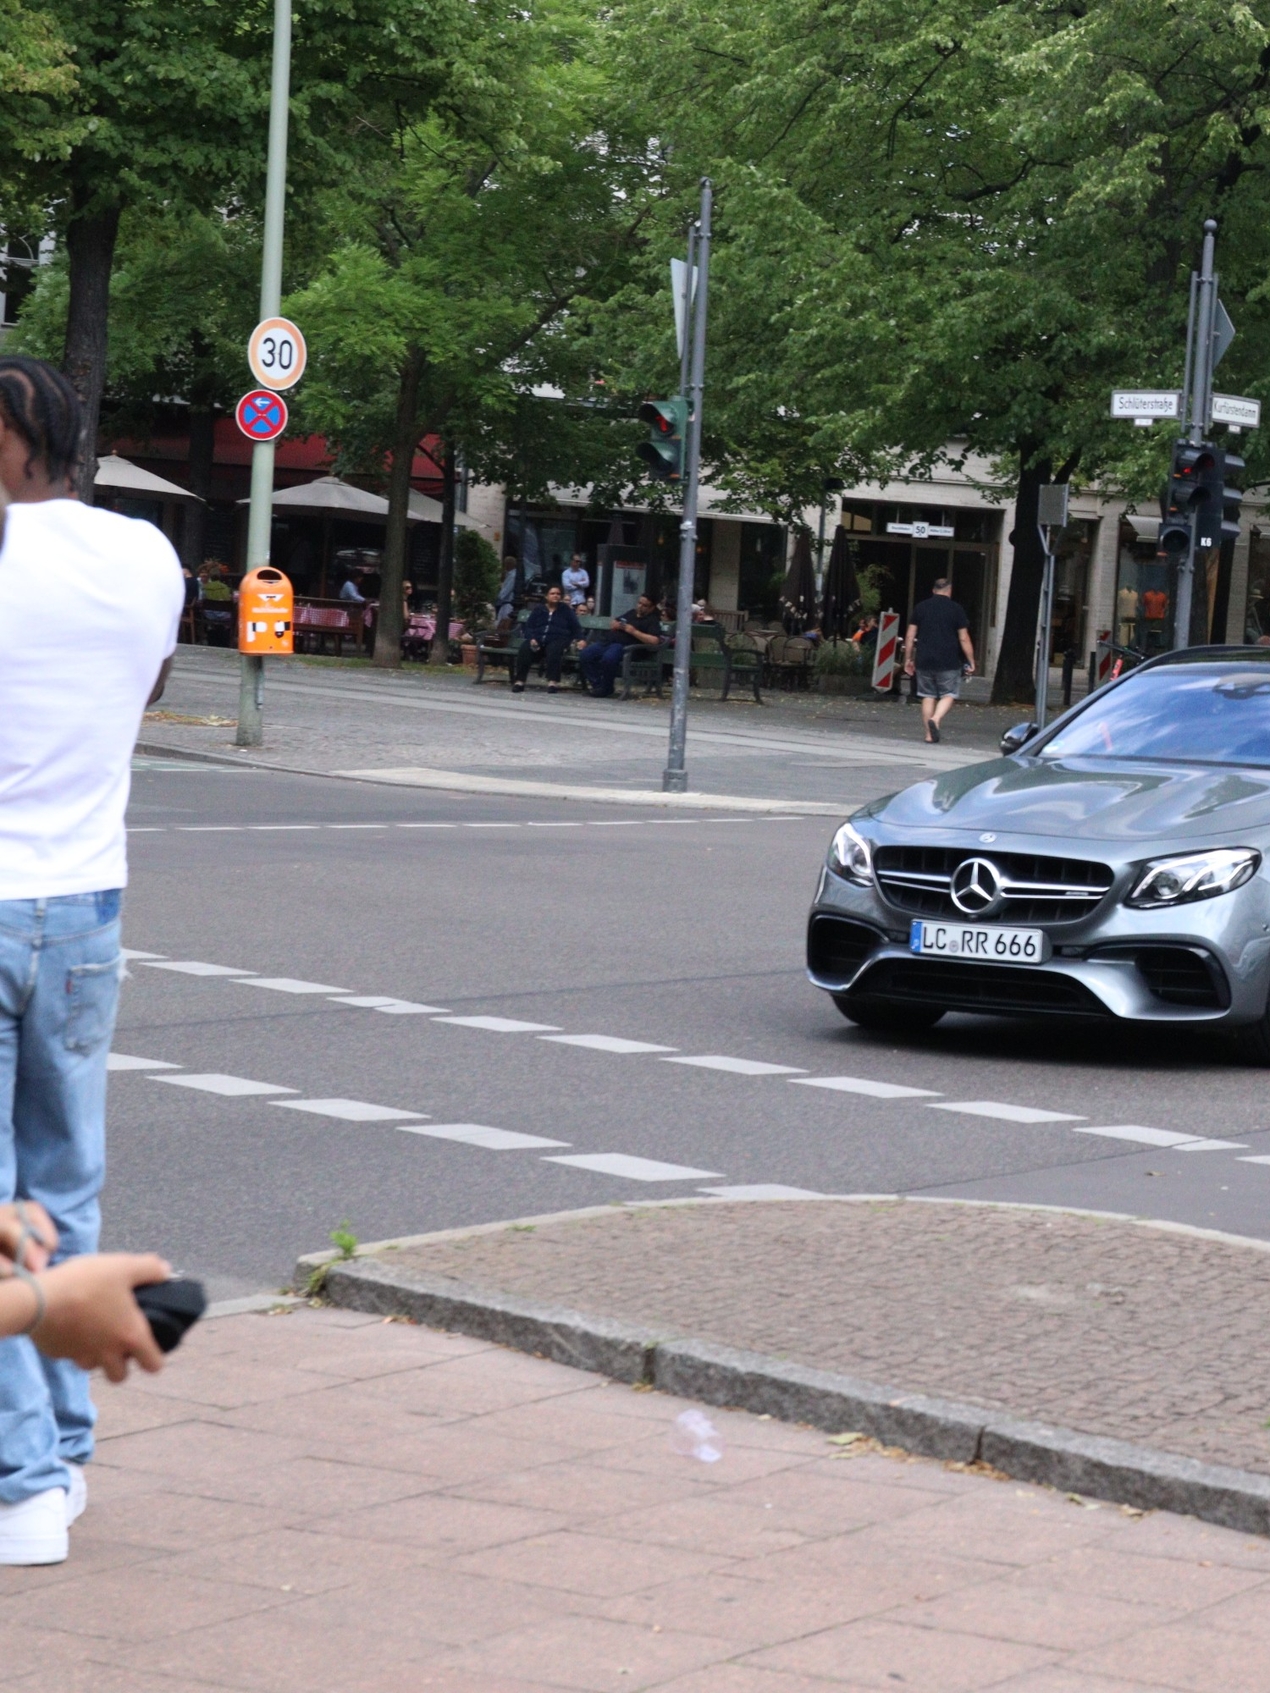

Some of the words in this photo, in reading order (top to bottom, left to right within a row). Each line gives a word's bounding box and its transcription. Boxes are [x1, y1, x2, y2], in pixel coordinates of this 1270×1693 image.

[262, 337, 293, 370] 30
[1118, 396, 1173, 413] Schlüterstraße
[1213, 400, 1257, 419] Kurfürstendamm
[915, 525, 926, 535] 50
[1200, 536, 1212, 547] K6
[923, 926, 947, 950] LC
[961, 930, 988, 954] RR
[994, 933, 1036, 957] 666
